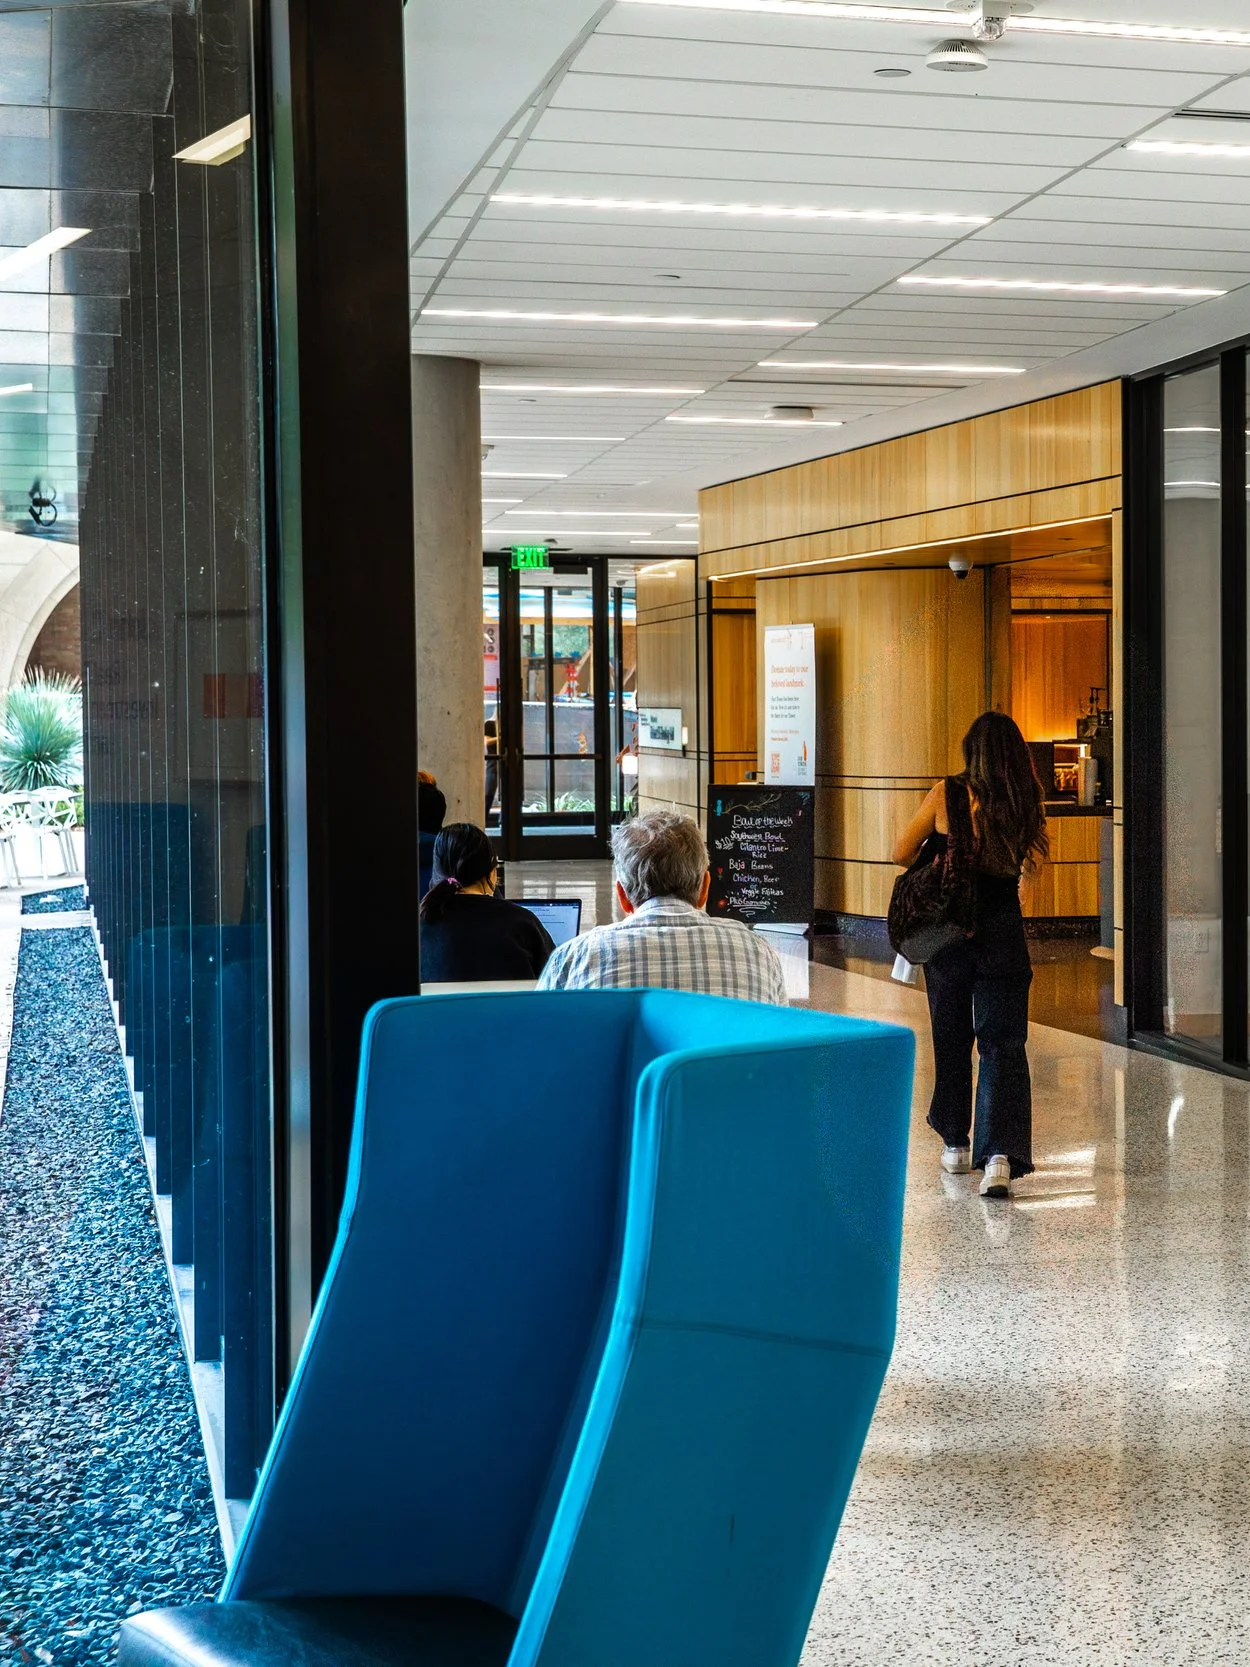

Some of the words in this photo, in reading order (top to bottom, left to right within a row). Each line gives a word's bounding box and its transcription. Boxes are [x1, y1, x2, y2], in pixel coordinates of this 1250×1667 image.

[517, 547, 545, 567] EXIT
[715, 837, 732, 849] $10
[740, 842, 767, 851] Cilantro
[729, 858, 746, 870] Baja
[751, 860, 774, 870] Beans
